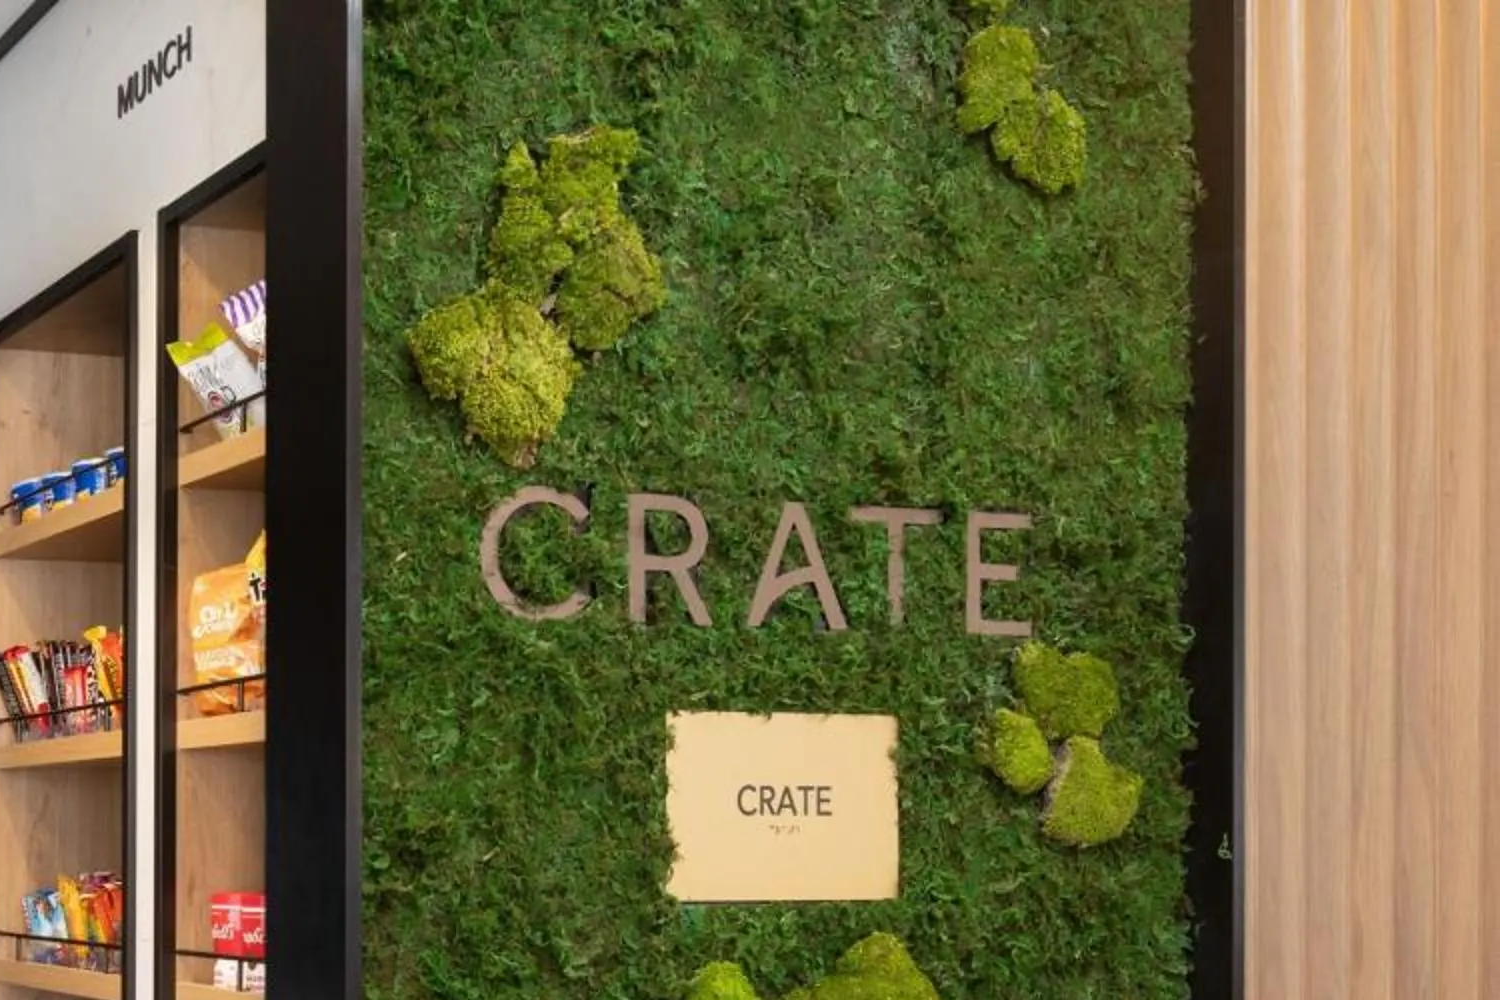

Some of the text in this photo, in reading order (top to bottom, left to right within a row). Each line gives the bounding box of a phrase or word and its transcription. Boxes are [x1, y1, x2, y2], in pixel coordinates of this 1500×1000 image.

[117, 26, 192, 119] MUNCH
[480, 485, 1034, 637] CRATE
[737, 784, 833, 816] CRATE
